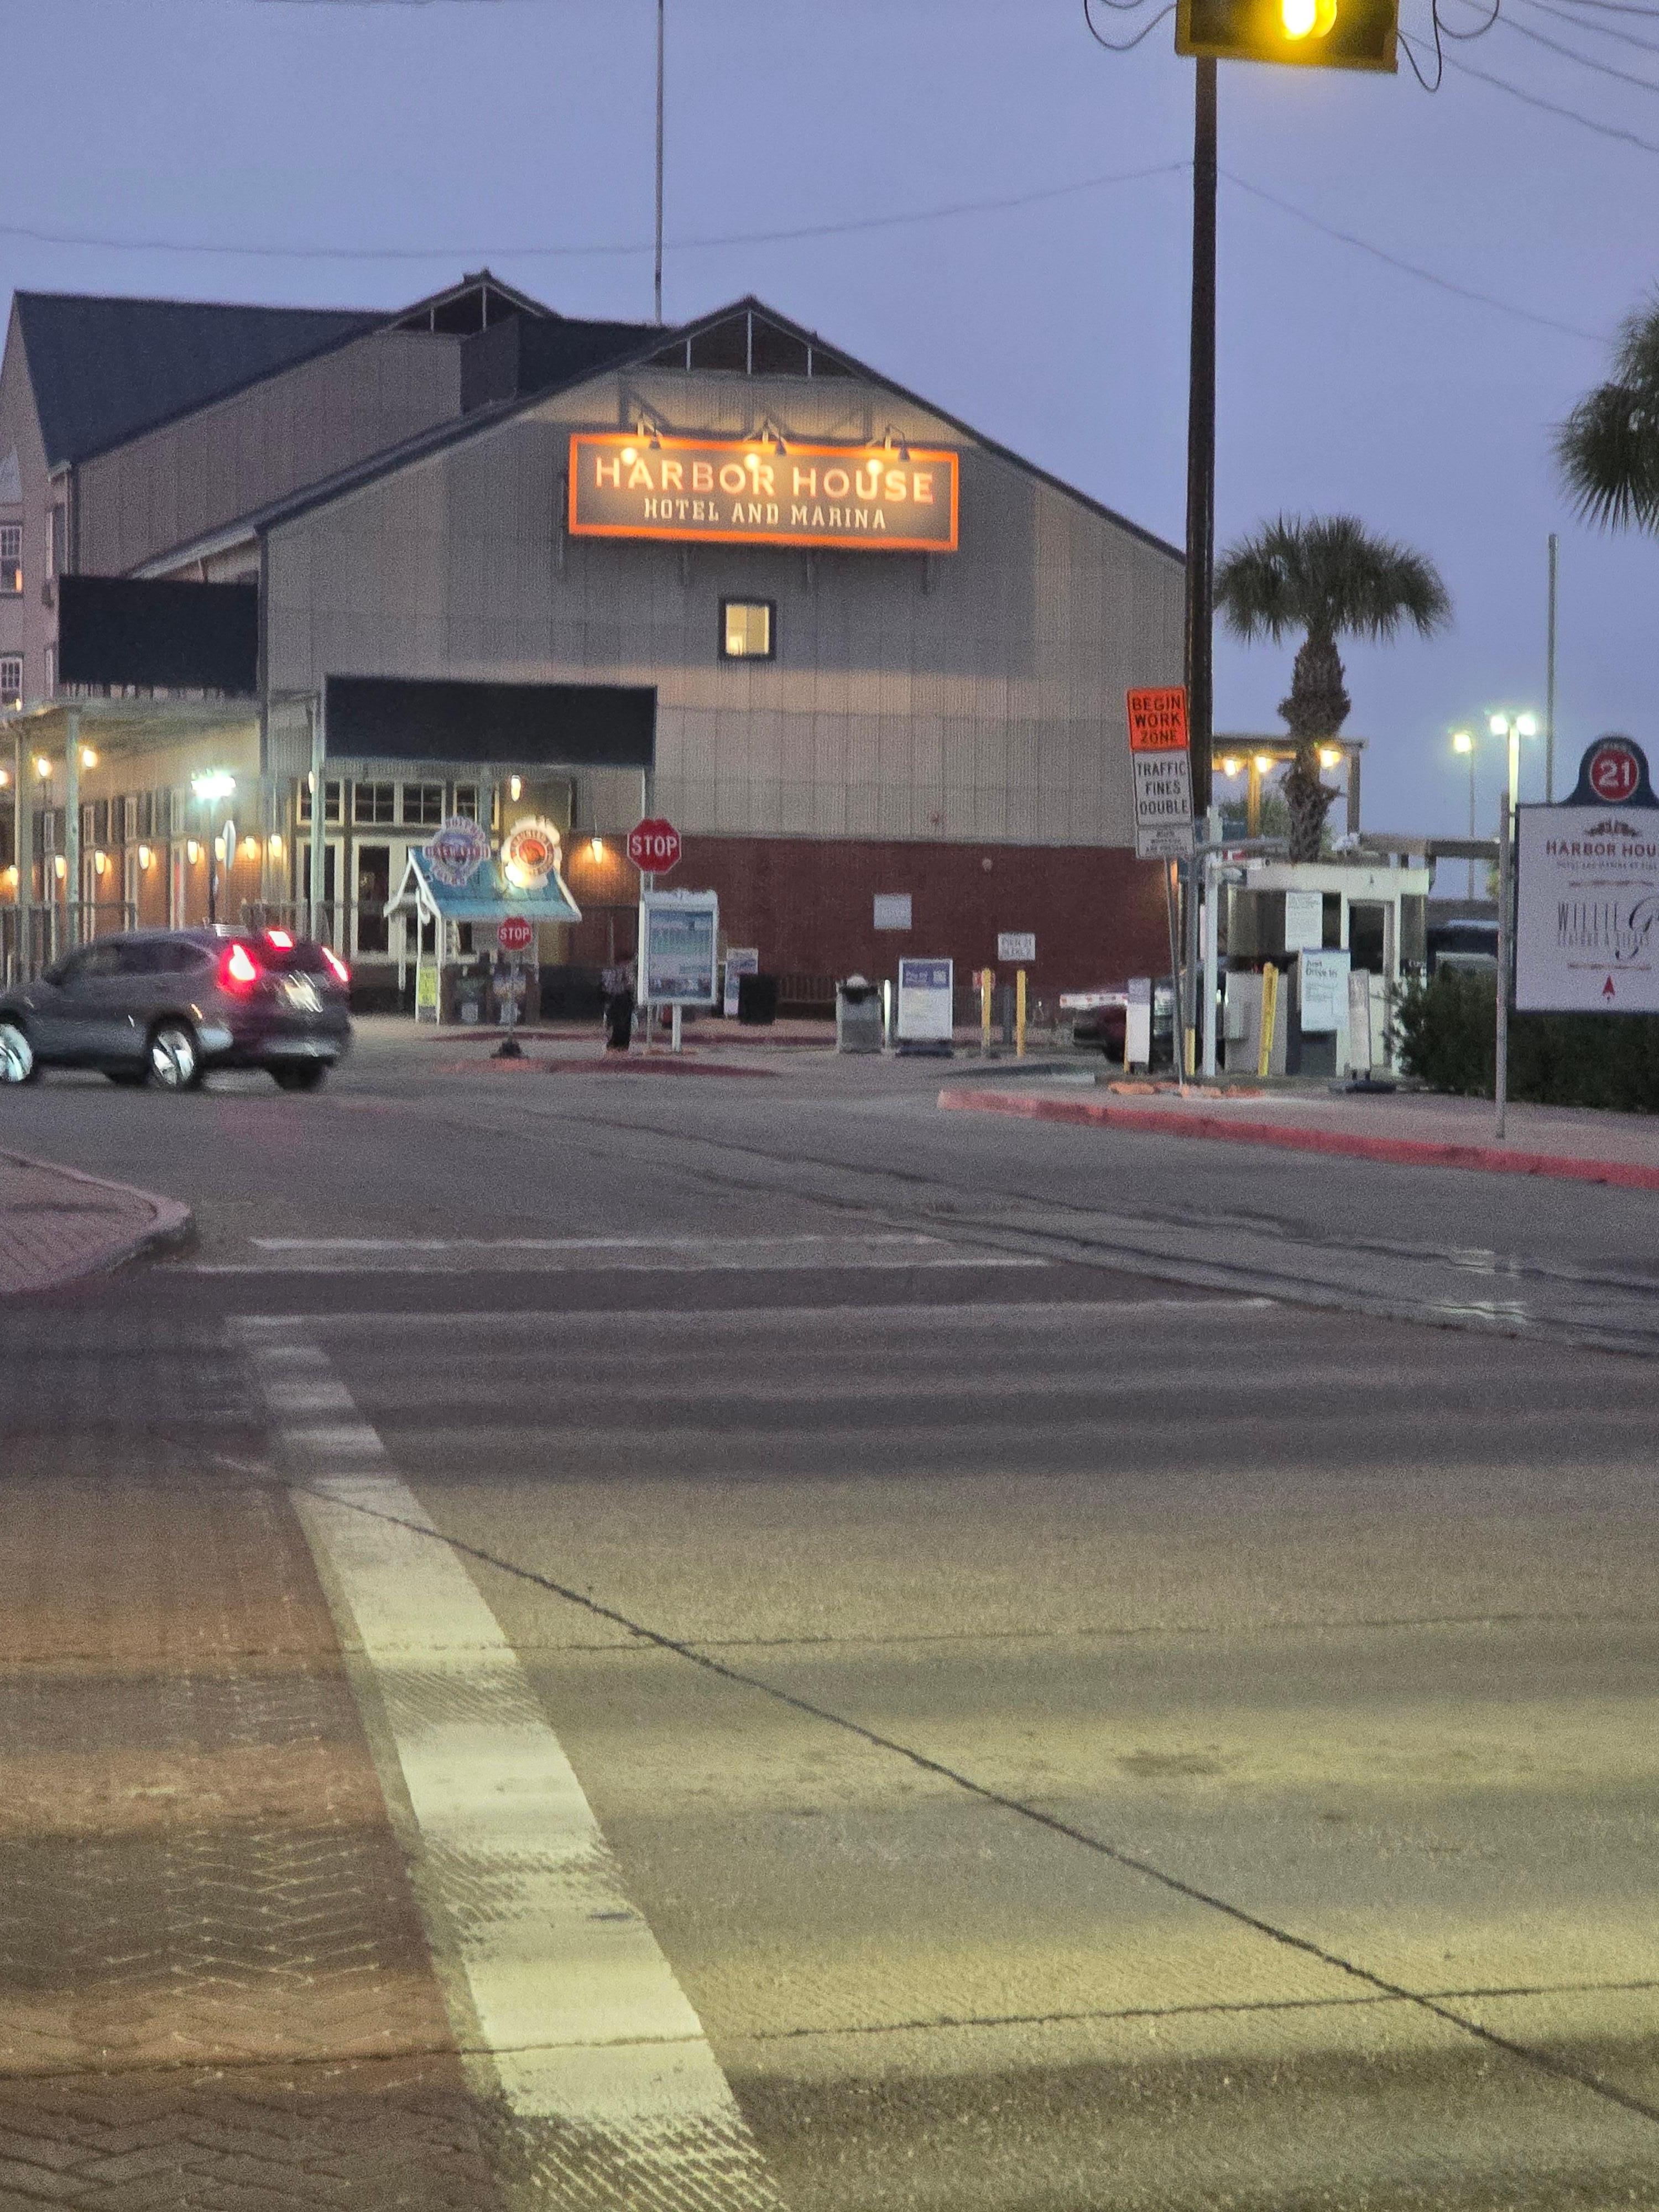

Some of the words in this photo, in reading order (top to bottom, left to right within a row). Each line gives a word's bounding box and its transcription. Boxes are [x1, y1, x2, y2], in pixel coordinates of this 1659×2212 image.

[596, 457, 775, 497] HARBOR
[793, 468, 934, 504] HOUSE
[644, 497, 719, 522] HOTEL
[732, 502, 779, 525] AND
[791, 504, 886, 530] MARINA
[1133, 695, 1181, 711] BEGIN
[1134, 712, 1182, 729] WORK
[1140, 729, 1177, 744] ZONE
[1137, 760, 1187, 776] TRAFFIC
[1599, 759, 1630, 787] 21
[1145, 780, 1181, 796] FINES
[1139, 799, 1188, 816] DOUBLE
[631, 835, 677, 856] STOP
[1546, 840, 1615, 856] HARBOR
[1622, 843, 1659, 857] HOU
[500, 926, 530, 941] STOP
